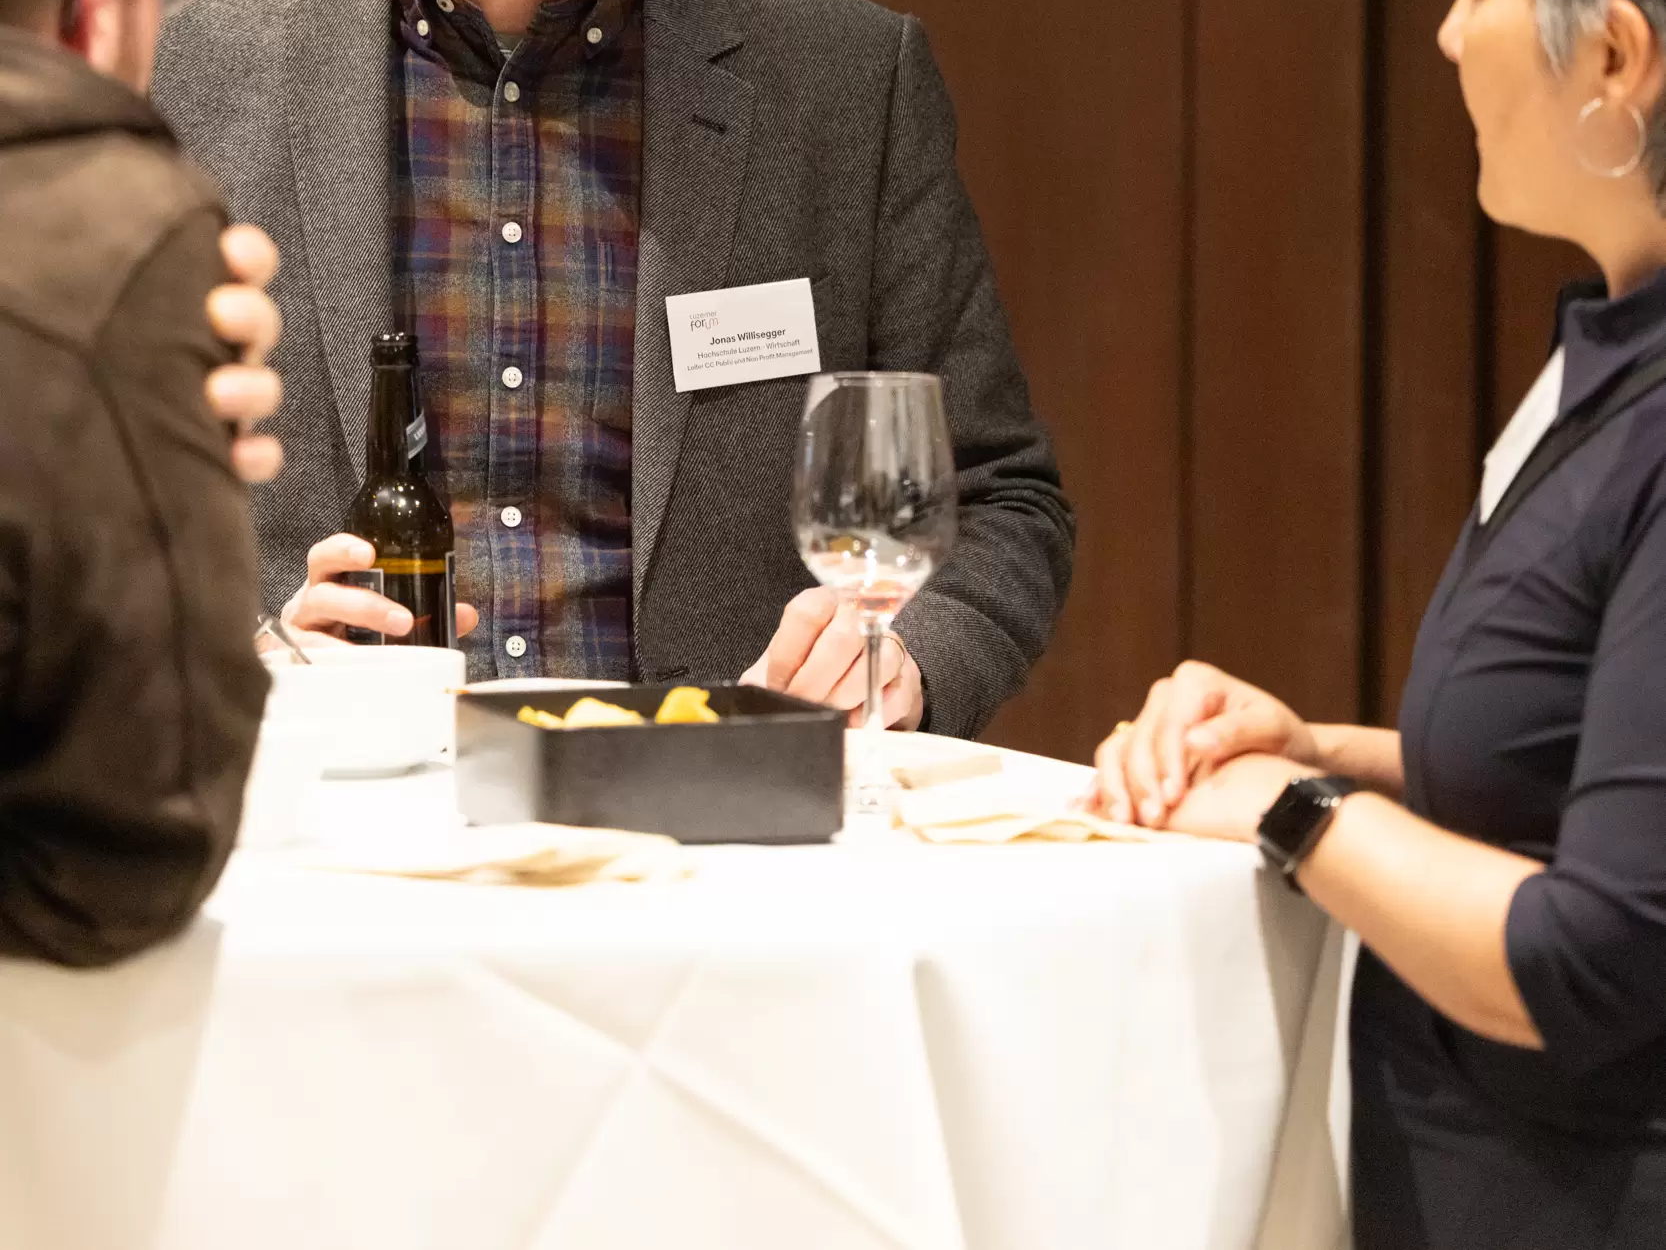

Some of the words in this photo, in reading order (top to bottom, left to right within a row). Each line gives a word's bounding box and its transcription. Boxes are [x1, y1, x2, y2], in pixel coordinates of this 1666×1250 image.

[710, 335, 736, 346] Jonas
[737, 328, 786, 342] Willisegger
[697, 348, 738, 360] Hochschule
[738, 345, 761, 354] Luzern
[765, 339, 801, 350] Wirtschaft
[704, 361, 715, 369] CC
[715, 359, 734, 367] Public
[734, 357, 746, 365] und
[746, 355, 758, 363] Non
[759, 353, 775, 361] Profit
[775, 348, 813, 359] Management
